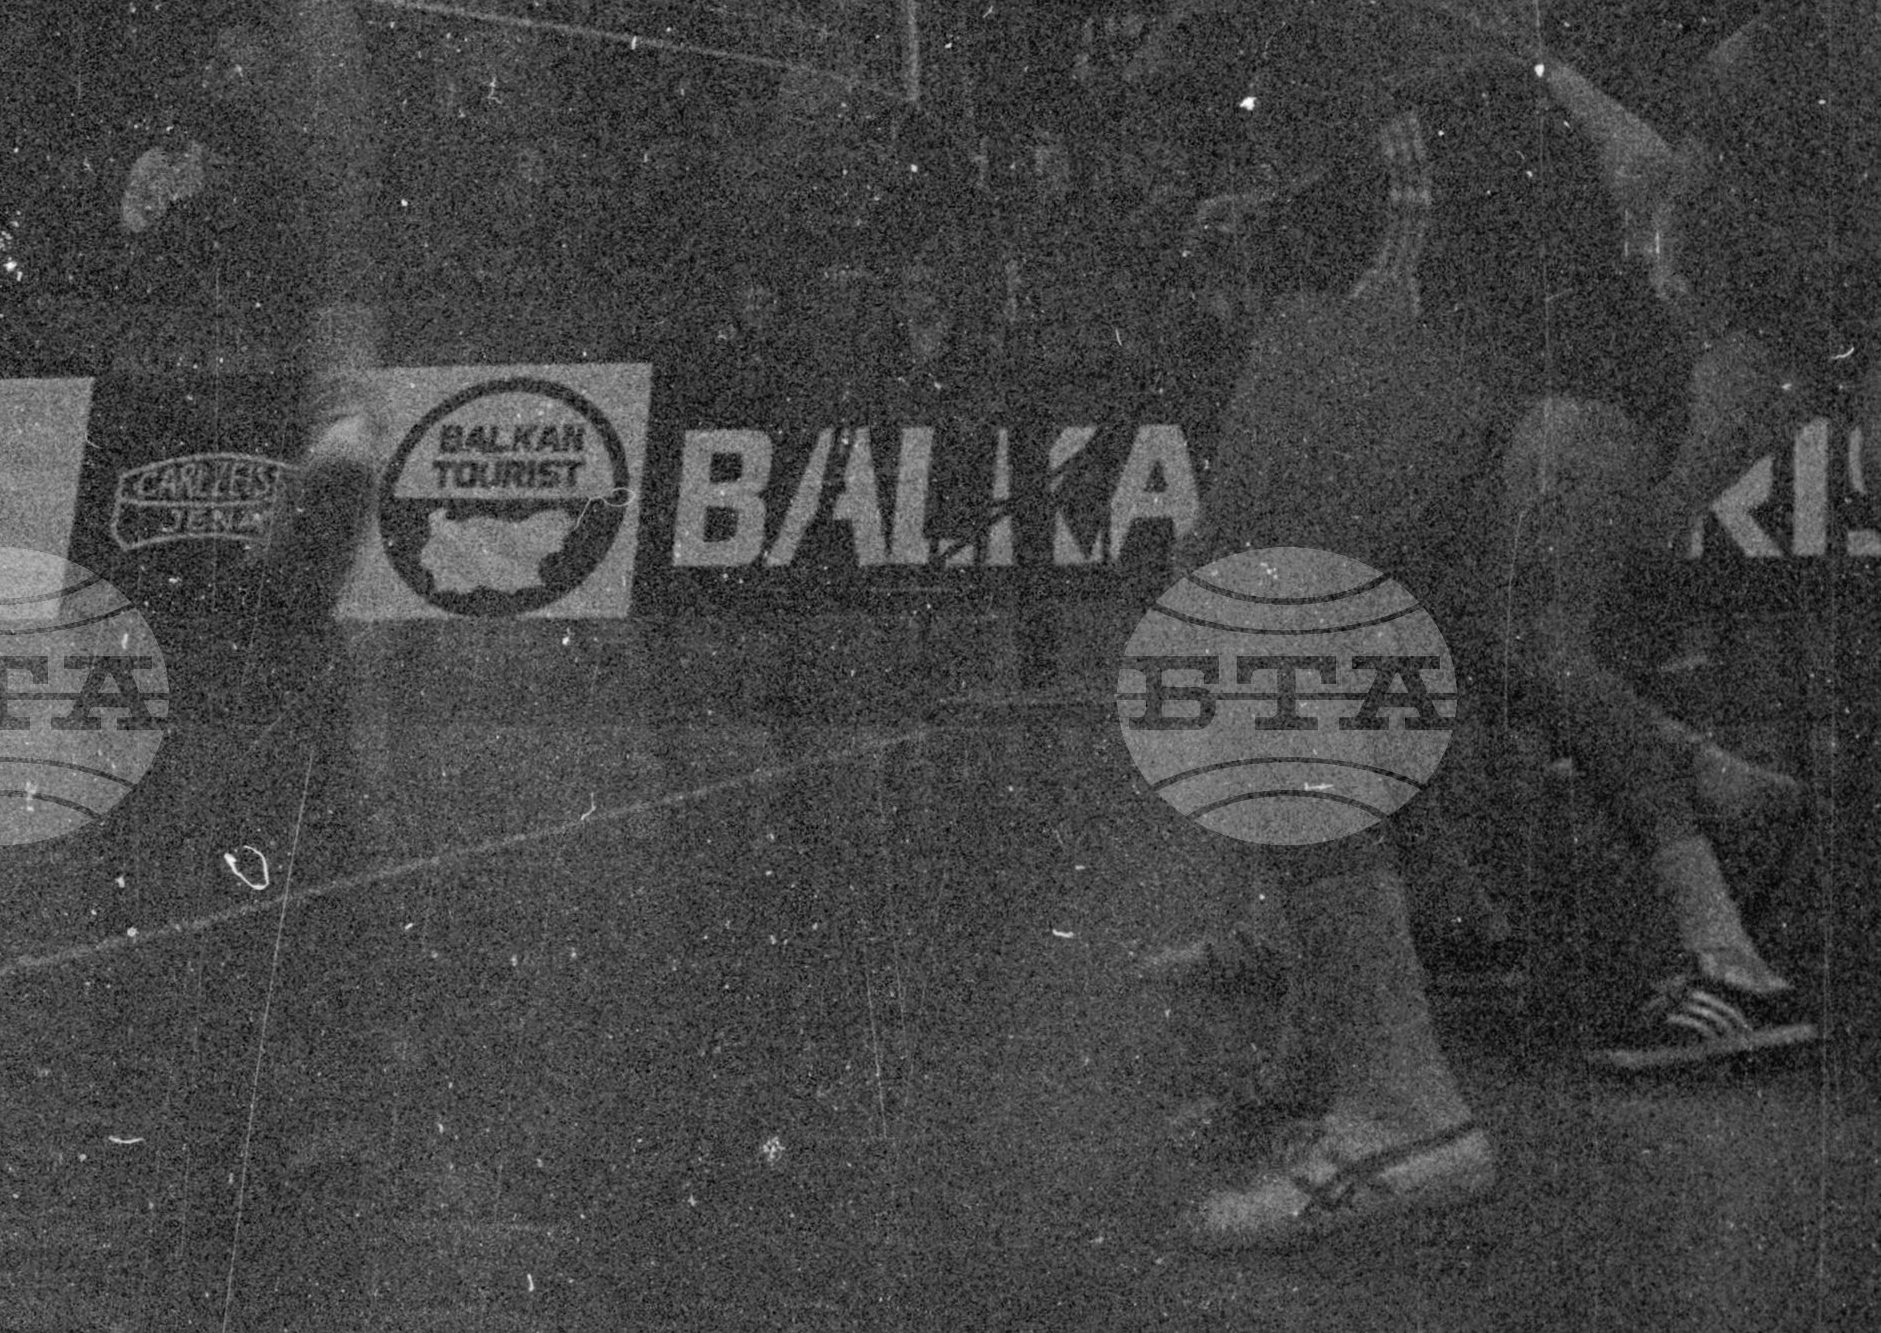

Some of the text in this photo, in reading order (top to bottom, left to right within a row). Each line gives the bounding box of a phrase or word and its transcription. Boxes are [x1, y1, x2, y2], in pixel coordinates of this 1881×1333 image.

[437, 423, 586, 454] BALKAN
[431, 459, 587, 489] TOURIST
[671, 422, 1202, 569] BALKA
